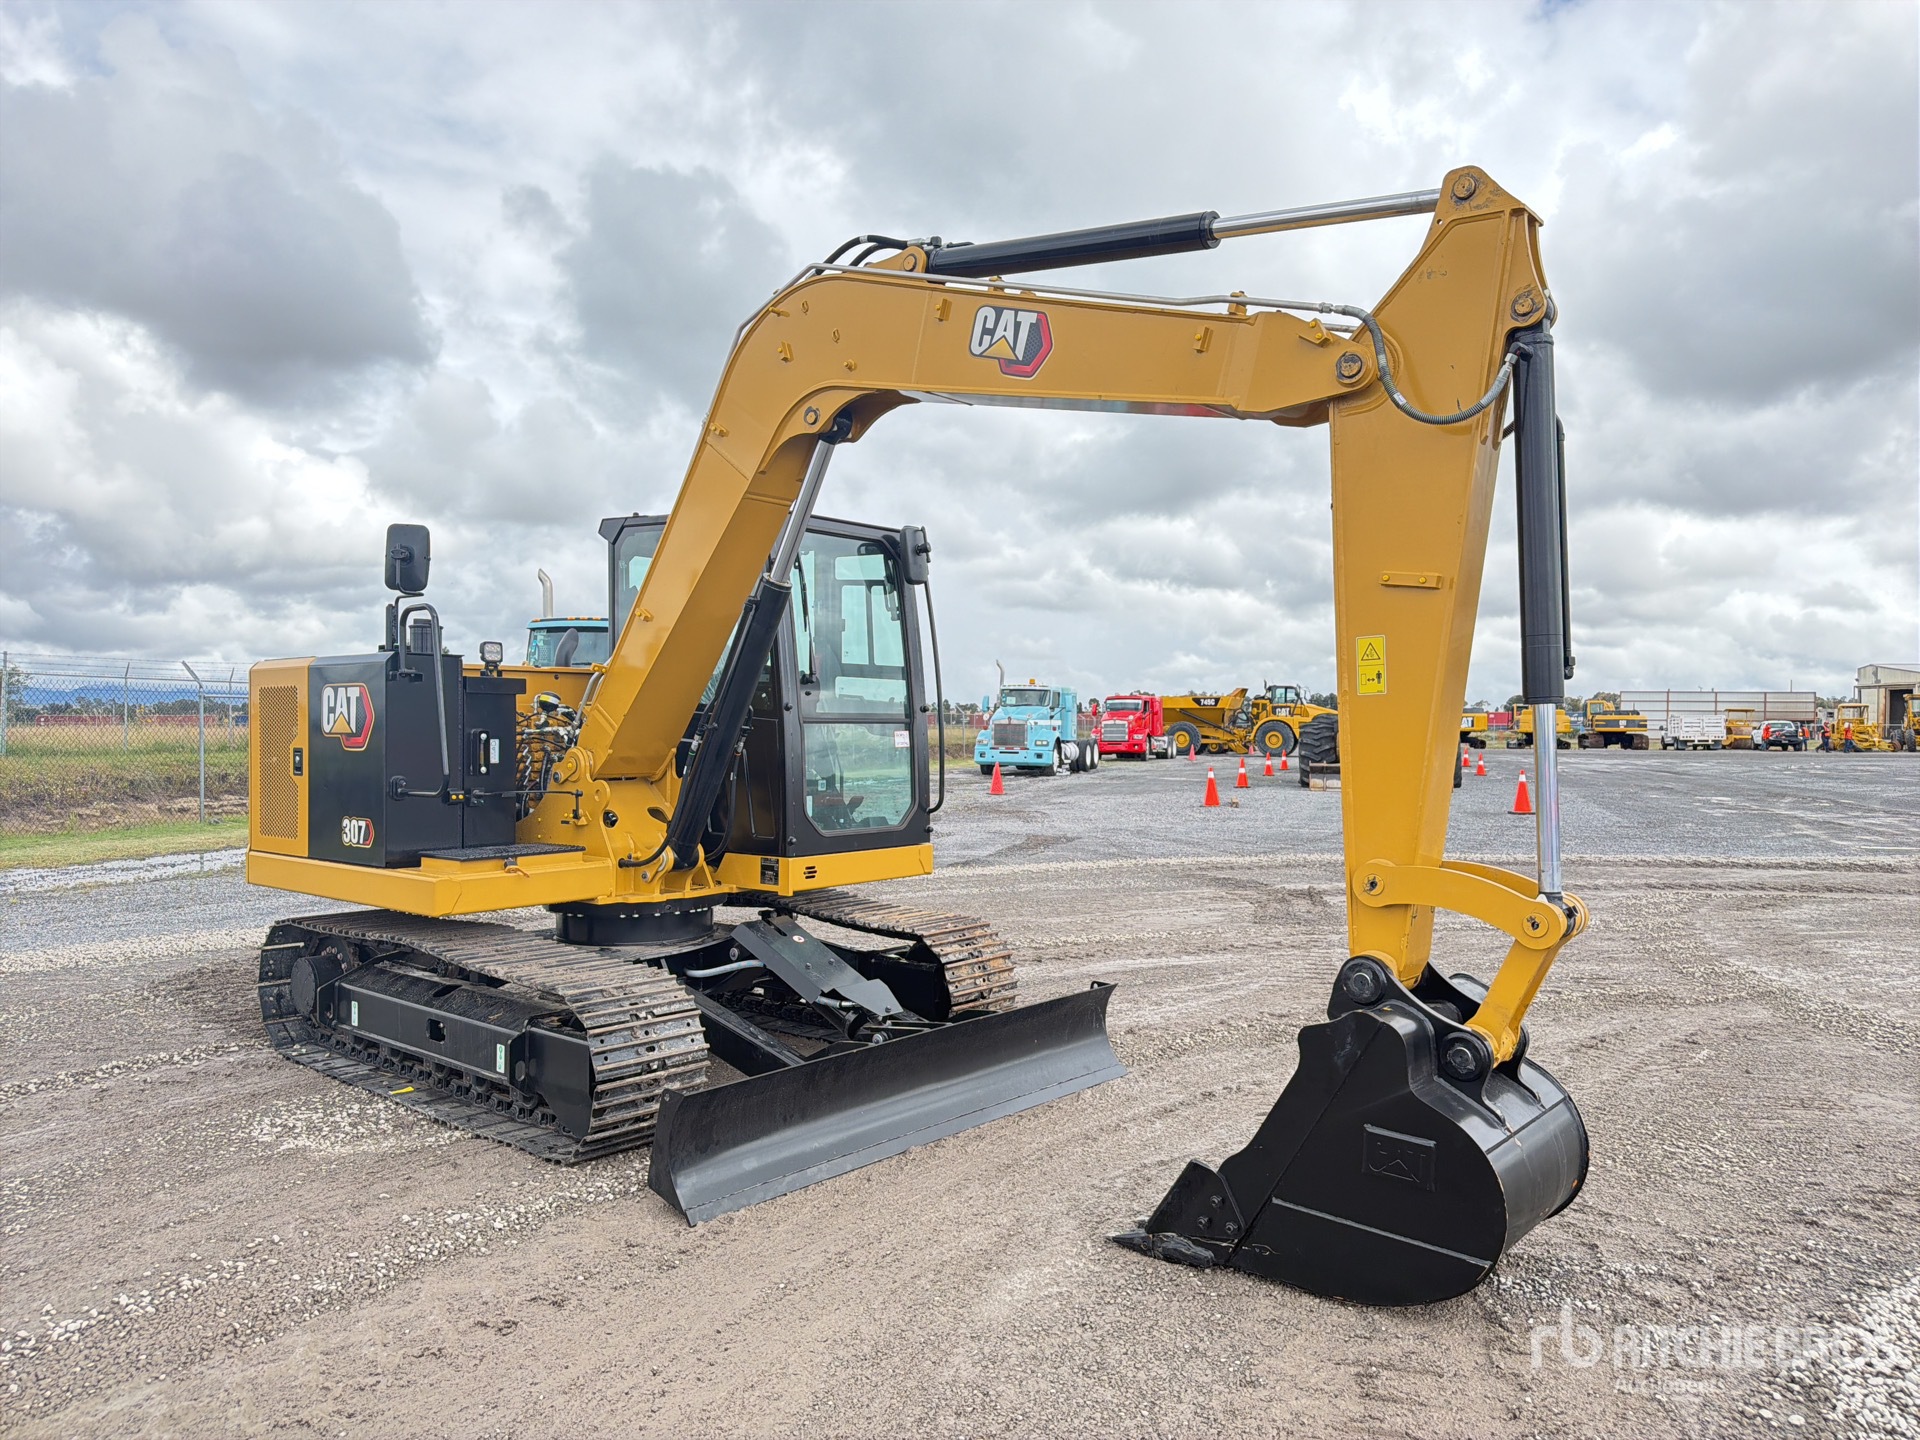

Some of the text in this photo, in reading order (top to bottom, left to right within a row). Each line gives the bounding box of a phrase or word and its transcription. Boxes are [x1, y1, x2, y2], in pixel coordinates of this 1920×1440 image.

[970, 306, 1038, 361] CAT
[322, 686, 360, 733] CAT
[1275, 708, 1290, 716] CAT
[1460, 716, 1474, 728] AT
[342, 818, 367, 845] 307
